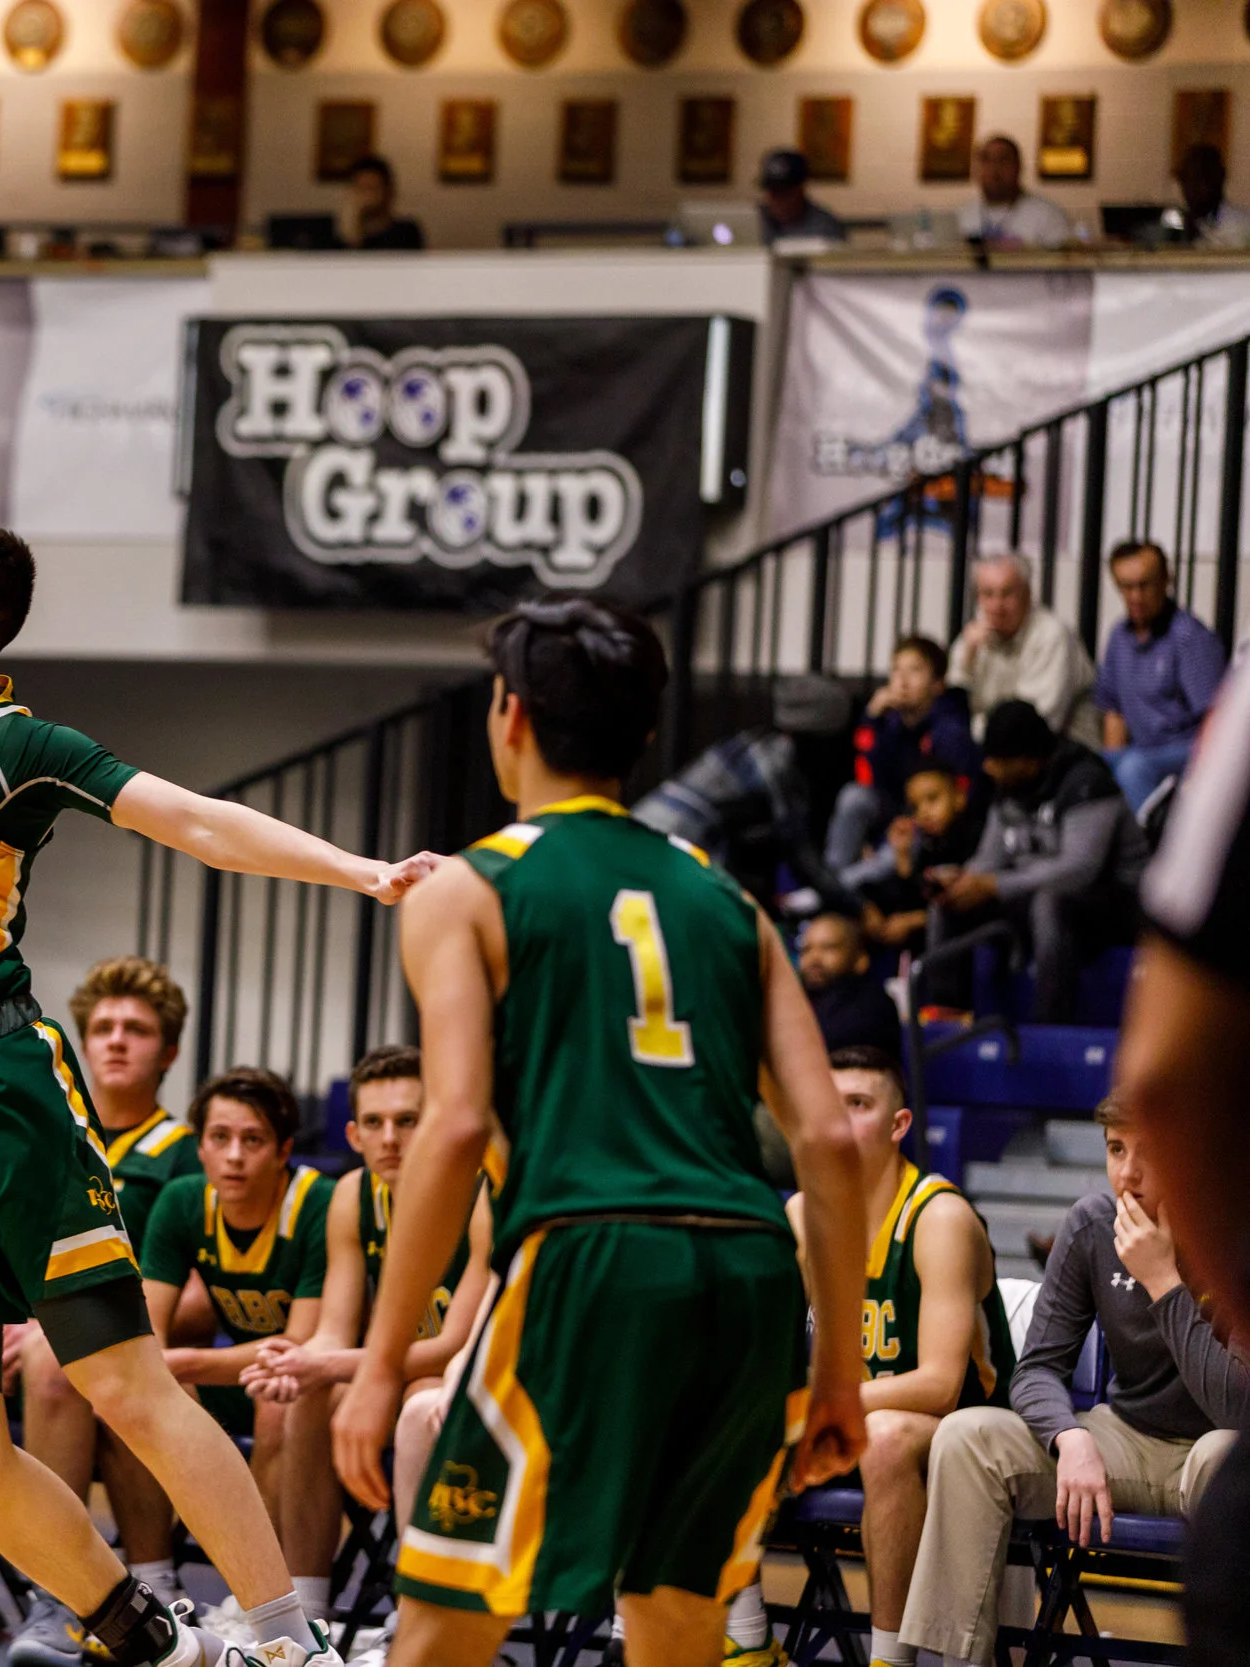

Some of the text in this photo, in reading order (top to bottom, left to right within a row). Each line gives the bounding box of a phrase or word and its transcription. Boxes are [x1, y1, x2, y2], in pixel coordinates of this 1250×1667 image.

[234, 343, 516, 466] Hoop
[301, 447, 626, 569] Group
[609, 888, 695, 1068] 1
[861, 1298, 901, 1361] BC
